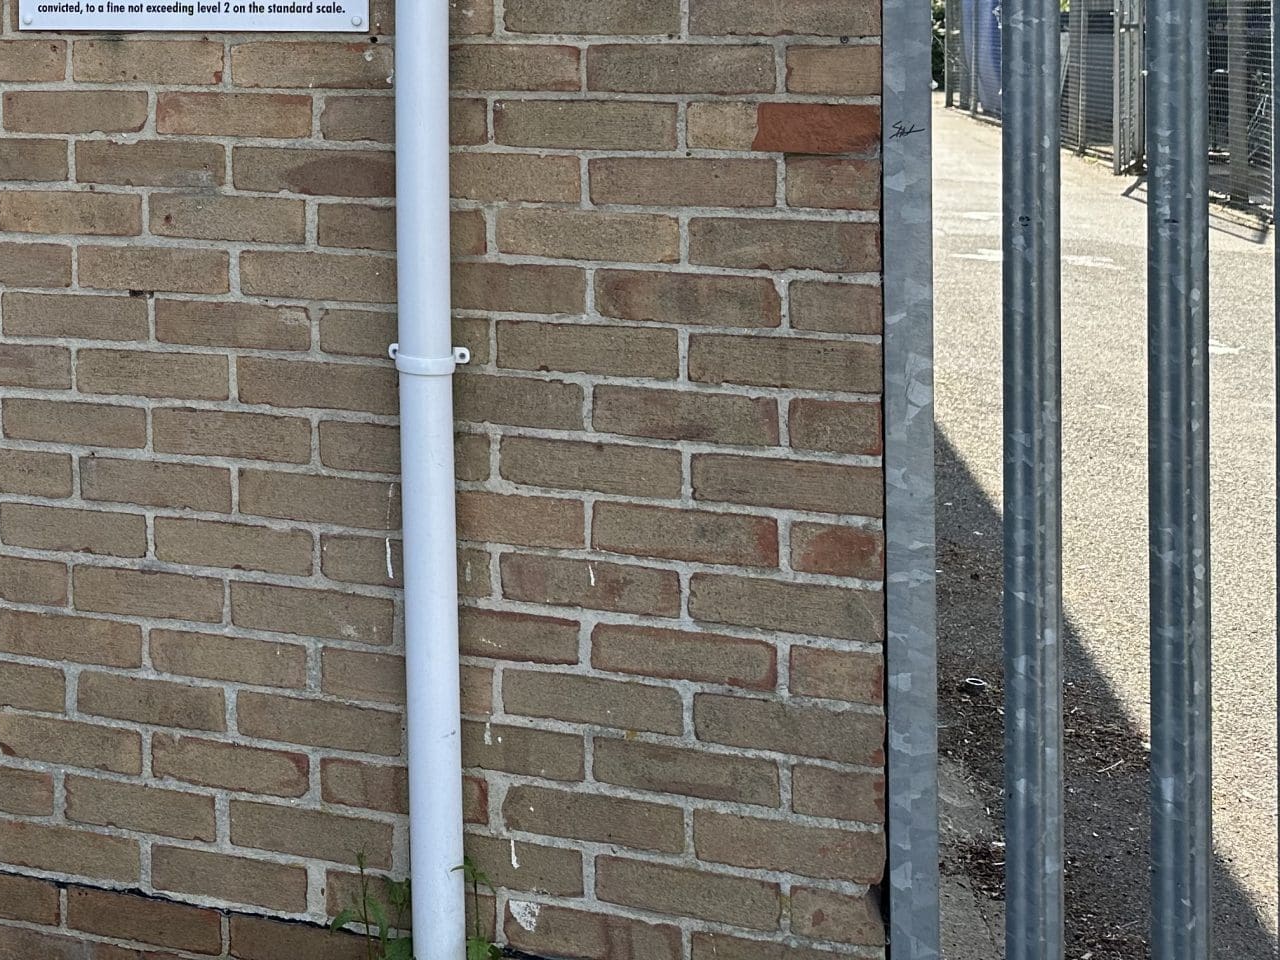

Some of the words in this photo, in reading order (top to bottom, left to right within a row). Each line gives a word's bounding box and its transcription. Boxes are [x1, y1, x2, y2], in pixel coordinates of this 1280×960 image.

[38, 2, 83, 15] convicted,
[86, 3, 95, 13] to
[98, 5, 104, 13] a
[107, 2, 125, 13] fine
[128, 3, 143, 13] not
[146, 2, 194, 15] exceeding
[197, 2, 221, 13] level
[224, 2, 230, 13] 2
[233, 4, 245, 13] on
[249, 2, 264, 13] the
[268, 2, 313, 13] standard
[316, 2, 345, 13] scale.
